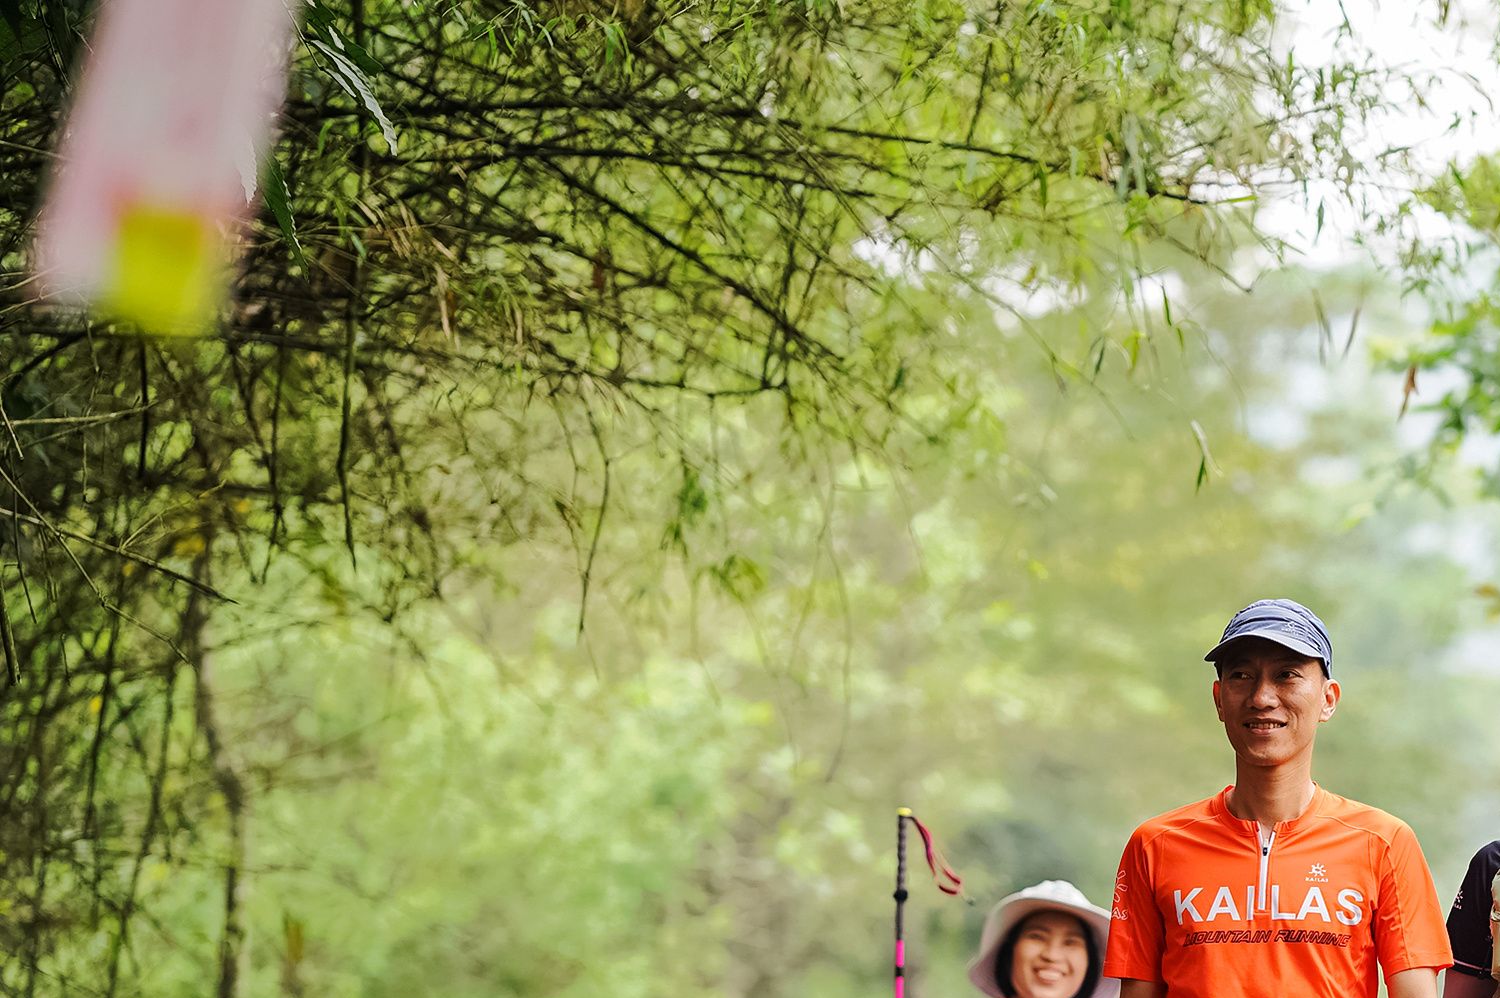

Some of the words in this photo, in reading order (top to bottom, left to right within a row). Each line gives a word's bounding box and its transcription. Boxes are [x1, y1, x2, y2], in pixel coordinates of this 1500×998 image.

[1173, 885, 1364, 926] KAILAS
[1183, 929, 1273, 947] MOUNTAIN
[1275, 929, 1351, 947] RUNNING
